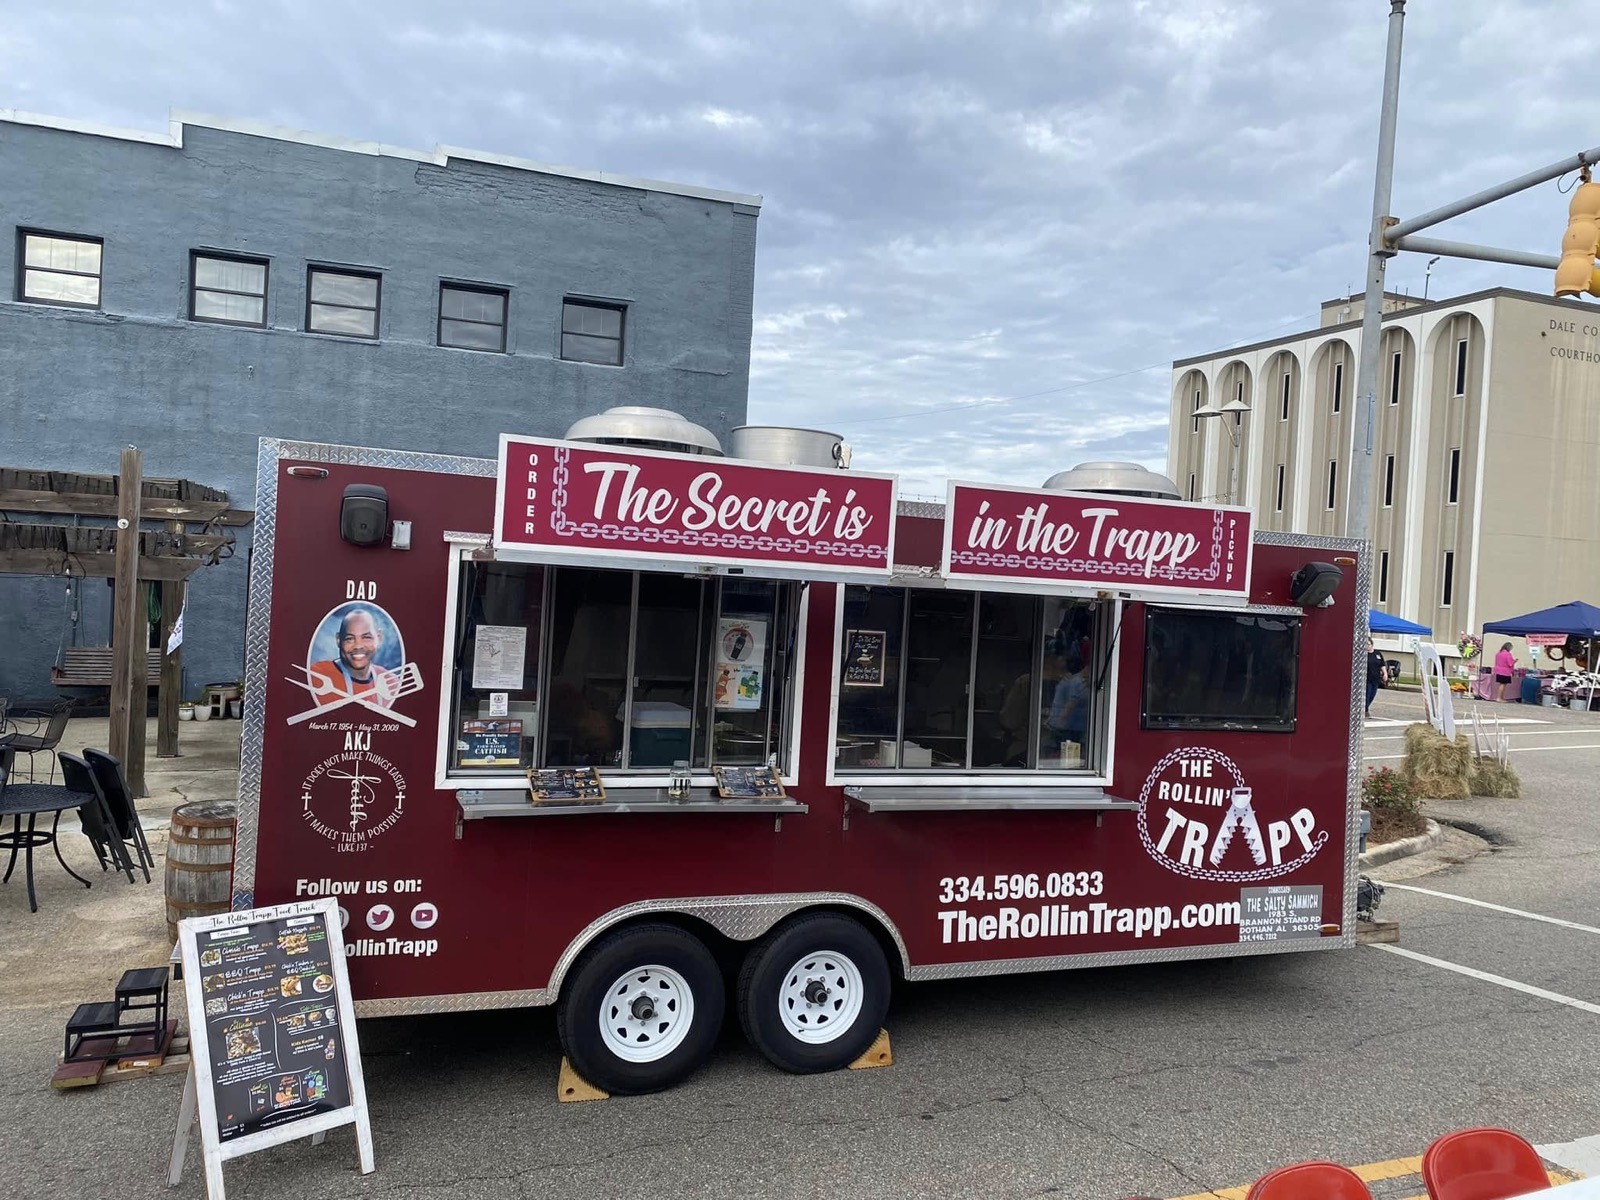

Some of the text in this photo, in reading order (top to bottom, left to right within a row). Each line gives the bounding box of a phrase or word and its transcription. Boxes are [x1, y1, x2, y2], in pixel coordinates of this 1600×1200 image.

[1549, 319, 1599, 337] DALE CO
[1550, 346, 1600, 363] COURTHO
[525, 453, 538, 534] ORDER
[583, 462, 874, 541] The Secret is
[967, 500, 1201, 580] in the Trapp
[346, 579, 377, 600] DAD
[308, 722, 328, 730] March
[338, 722, 353, 731] 1954
[358, 723, 371, 733] May
[381, 723, 400, 732] 2009
[344, 731, 371, 751] AKJ
[301, 751, 407, 791] IT DOES NOT MAKE THINGS EASIER
[1179, 759, 1213, 778] THE
[302, 807, 404, 843] IT MAKES THEM POSSIBLE
[337, 842, 368, 853] LUKE 137
[295, 878, 422, 896] Follow us on:
[939, 870, 1104, 903] 334.596.0833
[1246, 893, 1319, 913] THE SALTY SAMMICH
[211, 918, 223, 927] The
[249, 910, 272, 922] Trapp
[273, 905, 292, 918] Food
[294, 902, 316, 914] Truck
[938, 901, 1240, 944] TheRollinTrapp.com
[1240, 915, 1321, 926] BRANNON STAND RD
[1268, 909, 1297, 918] 1983 S.
[1239, 925, 1273, 934] DOTHAN
[1292, 923, 1320, 932] 36305
[345, 937, 438, 957] ollinTrapp
